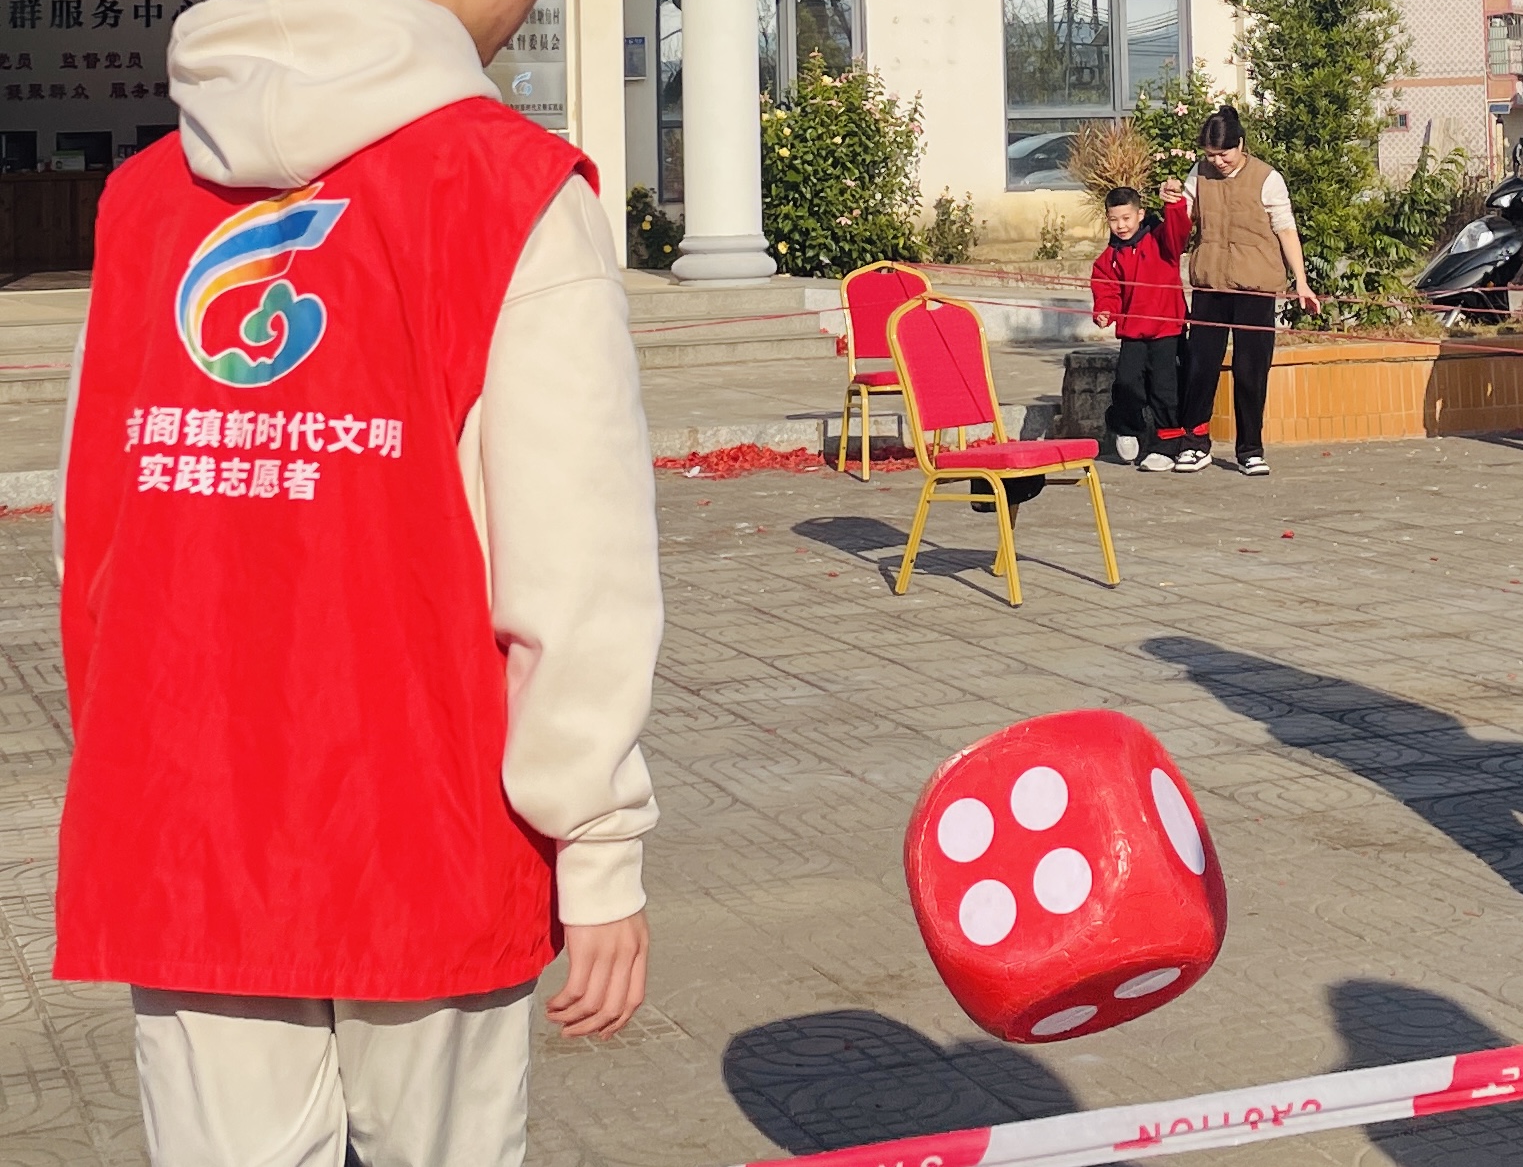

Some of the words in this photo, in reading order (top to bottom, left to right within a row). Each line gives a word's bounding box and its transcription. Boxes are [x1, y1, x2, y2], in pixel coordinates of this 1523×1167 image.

[137, 452, 322, 502] 实践志愿者
